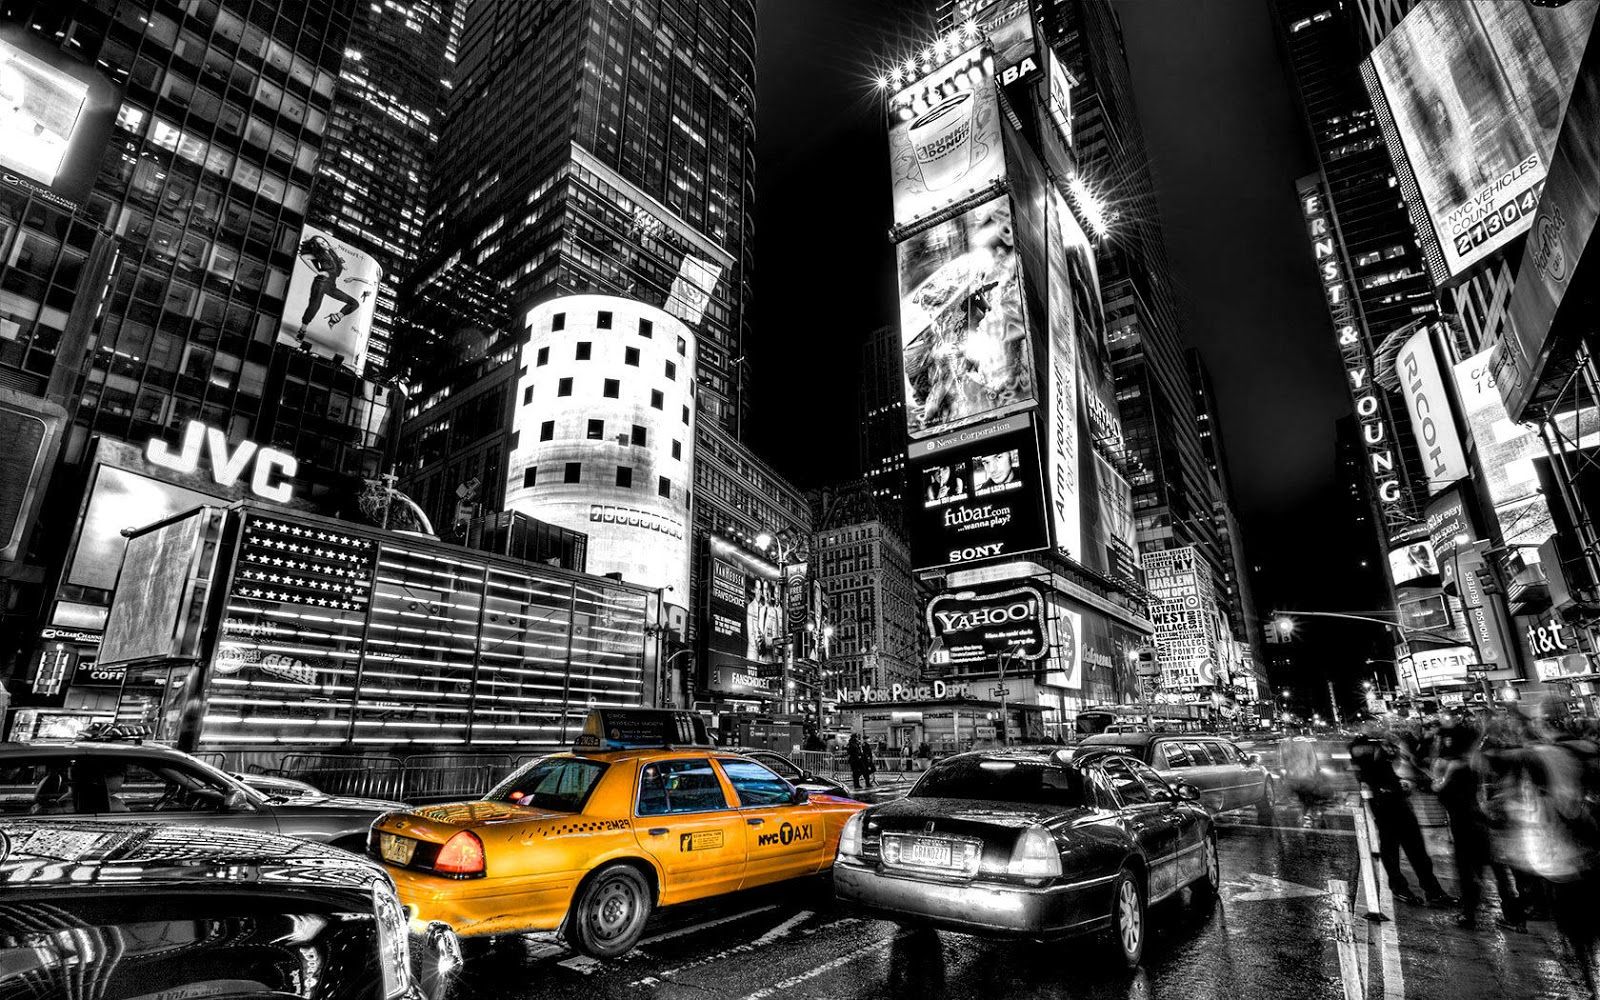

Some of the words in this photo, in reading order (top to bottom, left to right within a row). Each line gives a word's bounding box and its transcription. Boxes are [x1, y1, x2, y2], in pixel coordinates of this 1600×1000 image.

[1448, 201, 1474, 225] NYC
[1474, 155, 1538, 206] VEHICLES
[1452, 198, 1495, 235] COUNT
[1306, 196, 1343, 304] ERNST
[1339, 325, 1358, 346] &
[1350, 367, 1400, 502] YOUNG
[1403, 351, 1447, 478] RICOH
[936, 438, 957, 449] News
[960, 422, 1010, 441] Corporation
[147, 420, 298, 503] JVC
[1055, 463, 1065, 522] Arm
[990, 514, 1011, 528] play?
[950, 543, 1004, 562] SONY
[1147, 567, 1171, 578] EAST
[1174, 559, 1193, 570] NY
[1149, 573, 1194, 590] HARLEM
[1464, 571, 1480, 605] REUTERS
[1171, 585, 1197, 597] OPEN
[935, 600, 1037, 633] YAHOO!
[1152, 603, 1184, 613] ASTORIA
[1152, 612, 1185, 625] WEST
[1154, 622, 1188, 633] VILLAGE
[1172, 639, 1207, 648] COLLEGE
[1173, 647, 1196, 655] POINT
[605, 819, 631, 831] 2M29
[758, 832, 779, 847] NYC
[780, 822, 813, 845] TAXI
